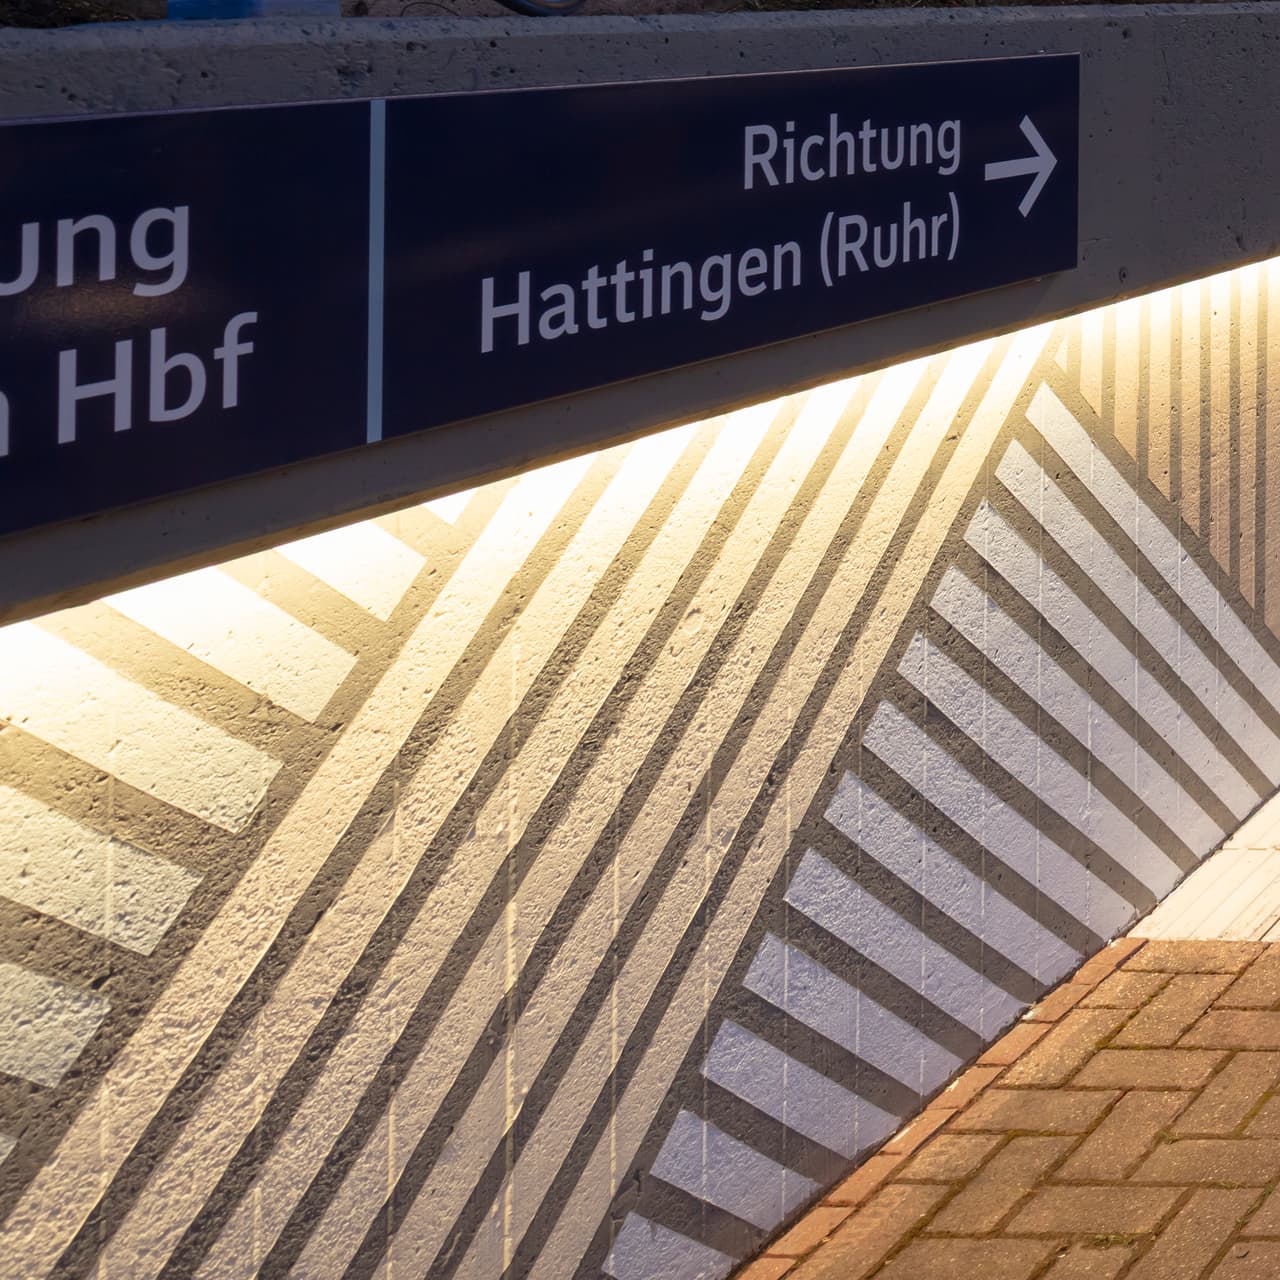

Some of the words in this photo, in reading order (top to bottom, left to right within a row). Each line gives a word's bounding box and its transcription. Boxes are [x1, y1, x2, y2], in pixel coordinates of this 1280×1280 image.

[743, 113, 961, 190] Richtung
[481, 240, 801, 353] Hattingen
[820, 192, 960, 287] (Ruhr)
[57, 310, 257, 443] Hbf
